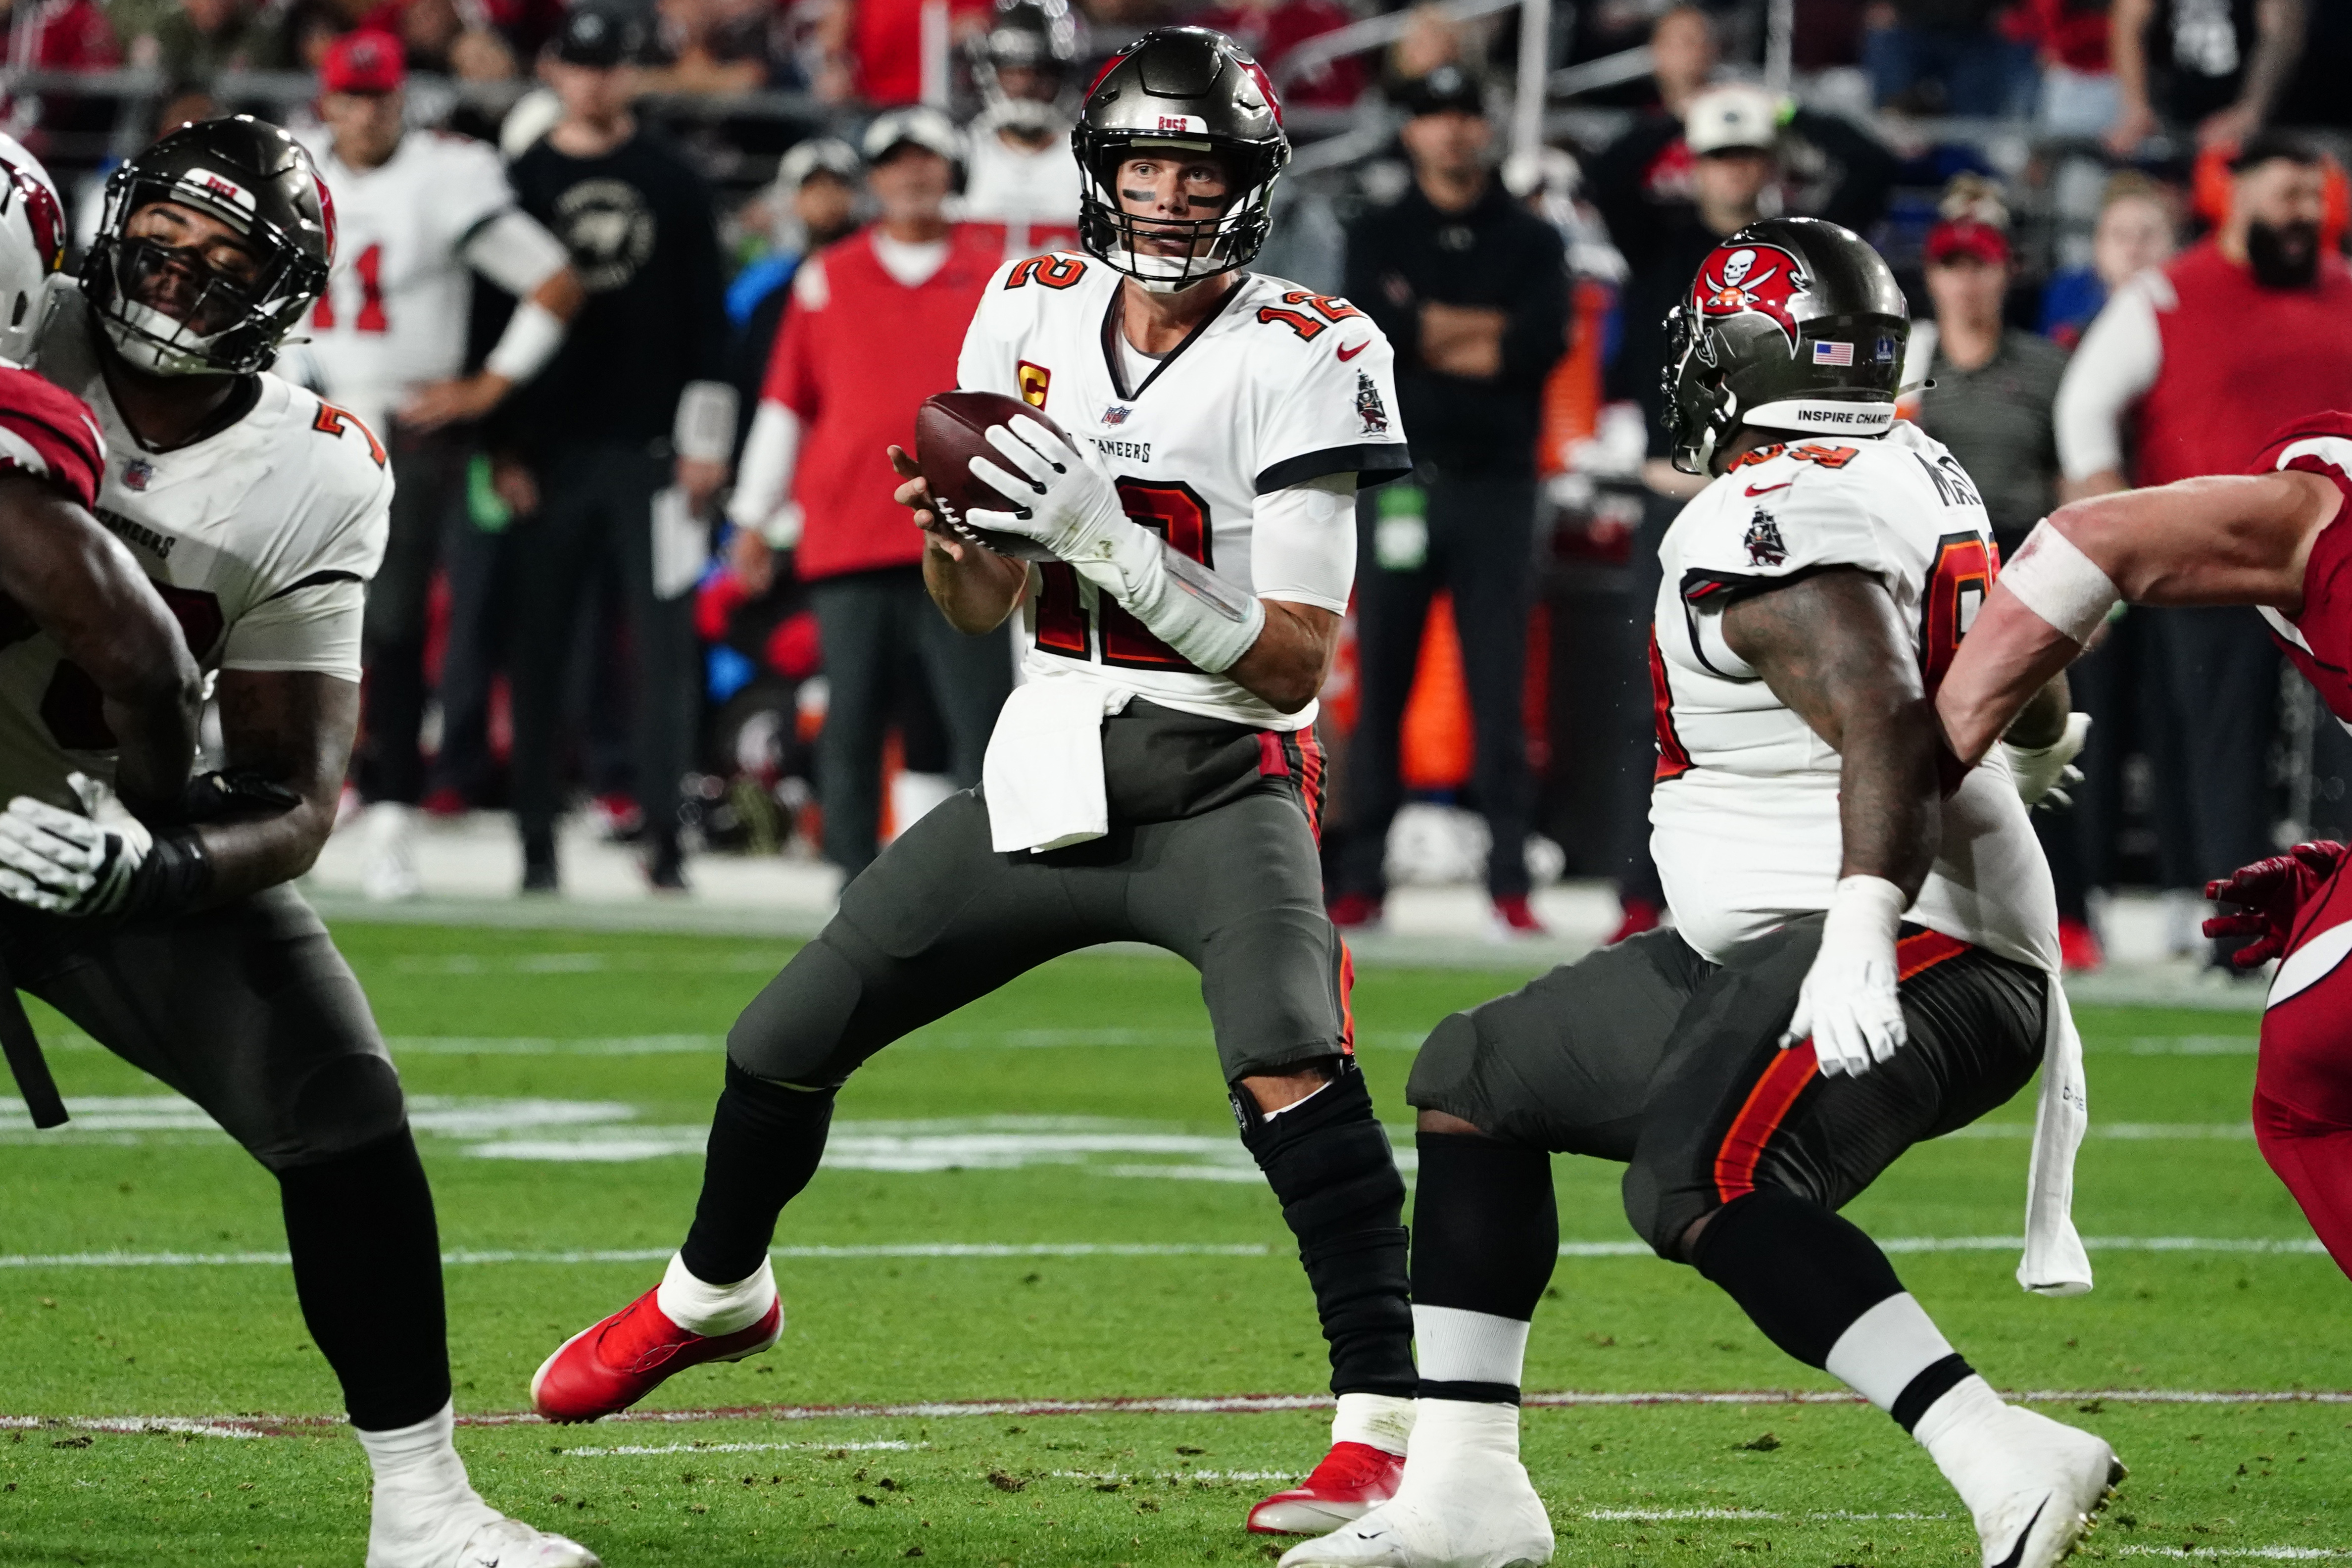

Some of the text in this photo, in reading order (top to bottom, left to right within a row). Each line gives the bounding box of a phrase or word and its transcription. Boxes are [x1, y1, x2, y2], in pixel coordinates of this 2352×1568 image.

[1256, 291, 1369, 343] 12
[1019, 365, 1047, 406] C
[1798, 410, 1854, 423] INSPIRE
[1089, 438, 1151, 463] ANEERS
